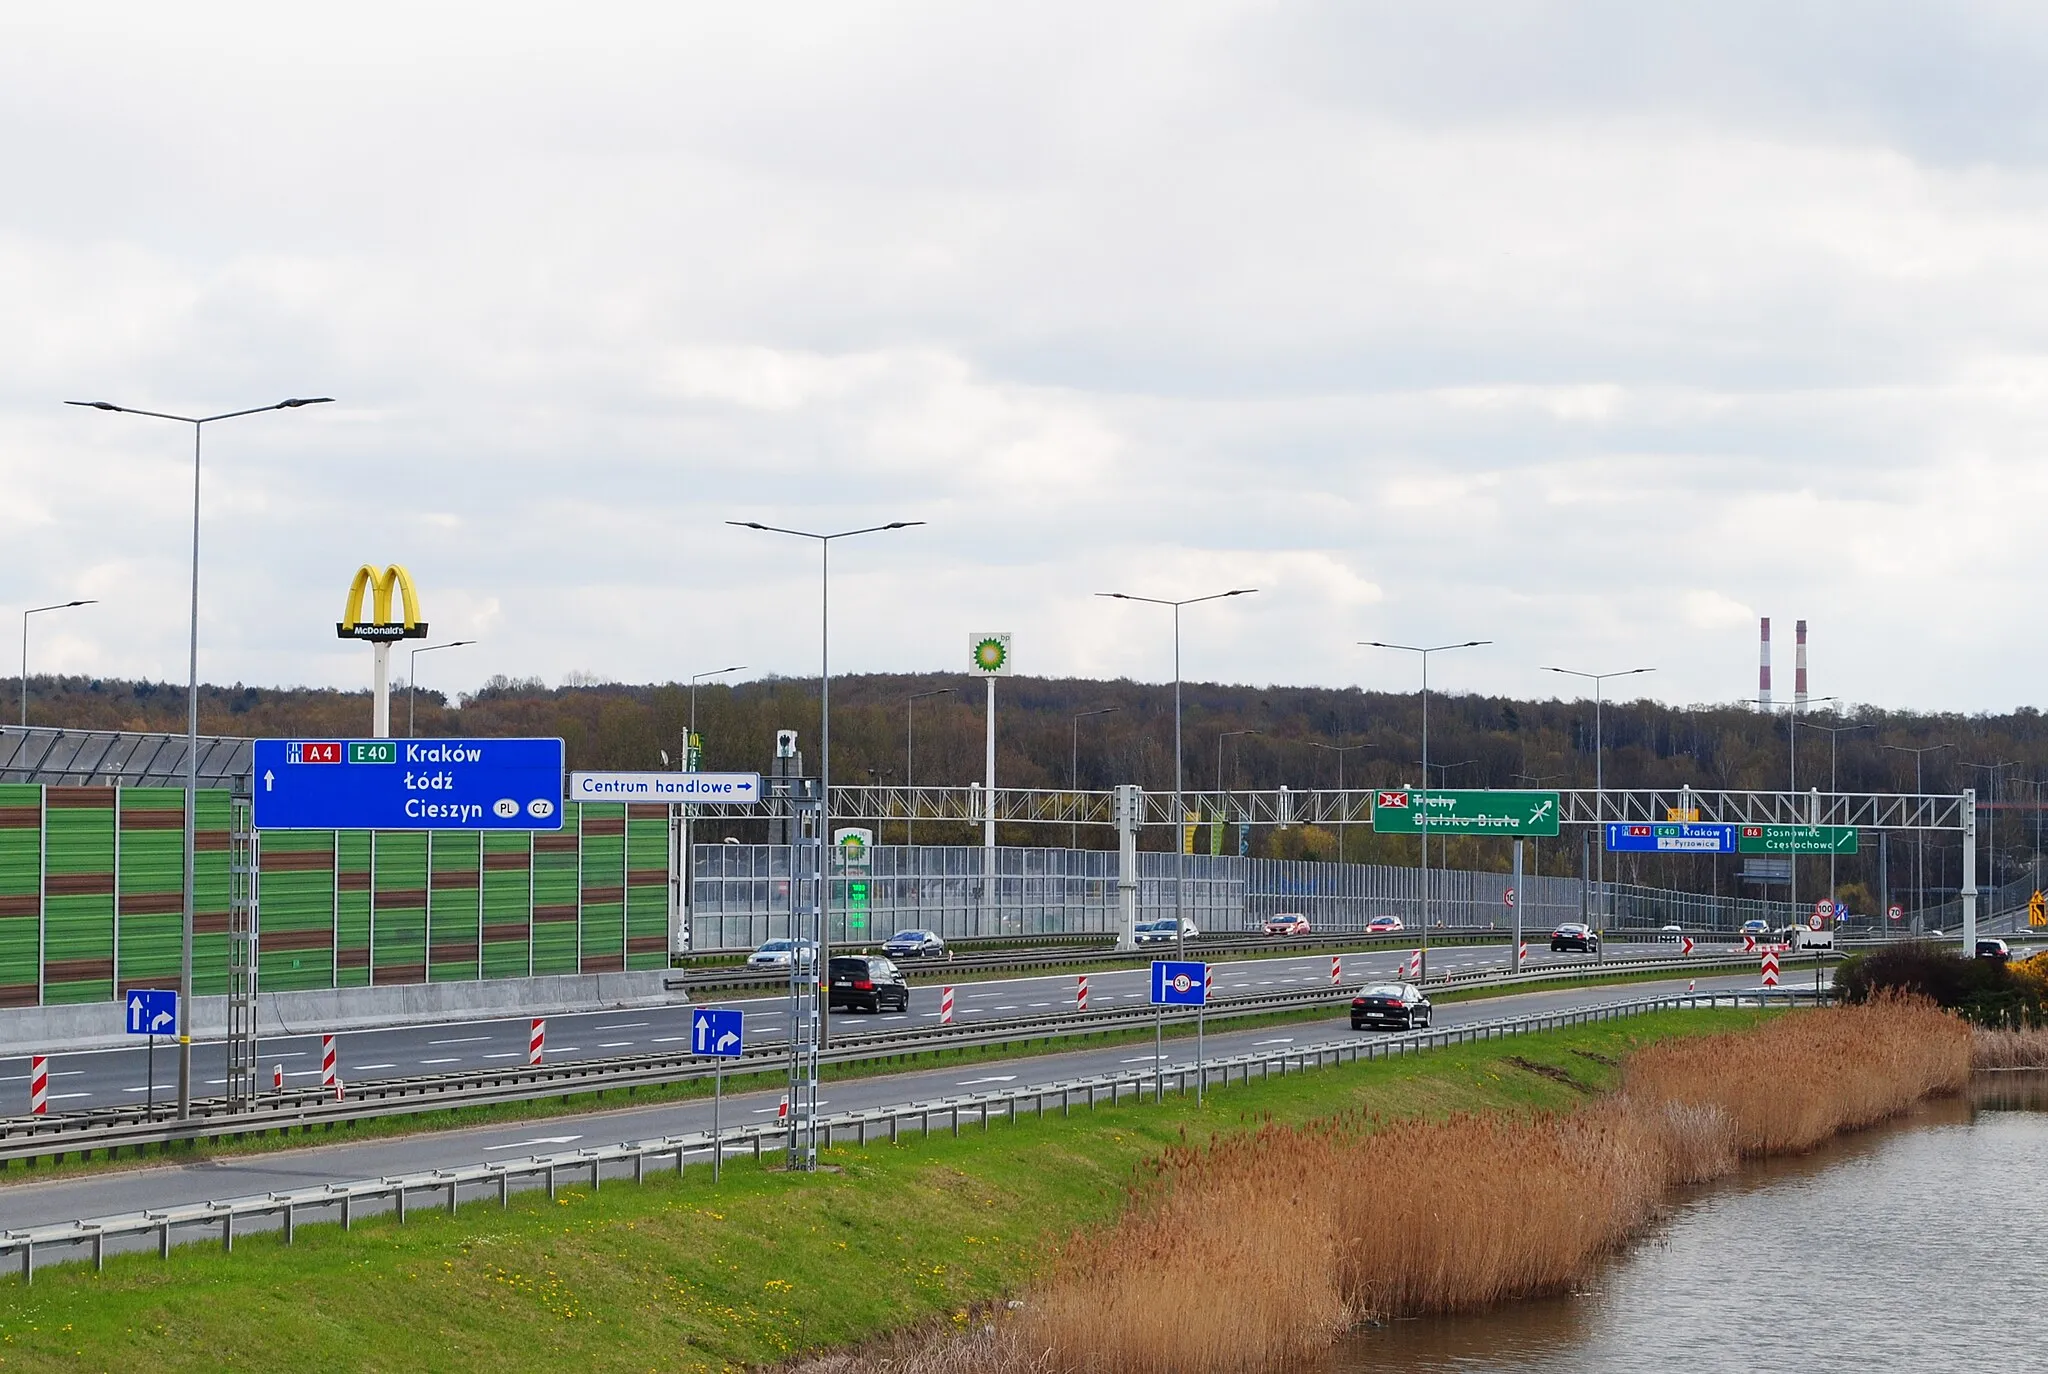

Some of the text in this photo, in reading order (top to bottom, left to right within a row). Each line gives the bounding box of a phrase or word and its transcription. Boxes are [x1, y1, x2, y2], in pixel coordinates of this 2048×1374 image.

[354, 626, 404, 635] McDonald's
[1000, 634, 1010, 642] bp
[406, 743, 481, 762] Kraków
[403, 771, 453, 790] Łódź
[582, 778, 732, 793] Centrum handlowe
[1413, 794, 1455, 811] Tchy
[405, 798, 483, 823] Cieszyn
[500, 803, 513, 814] PL
[532, 803, 548, 814] CZ
[1684, 827, 1720, 837] Kraków
[1767, 828, 1820, 837] Sosnowiec
[1675, 840, 1715, 849] Pyrzowice
[1819, 905, 1832, 913] 100
[1891, 909, 1900, 917] 70
